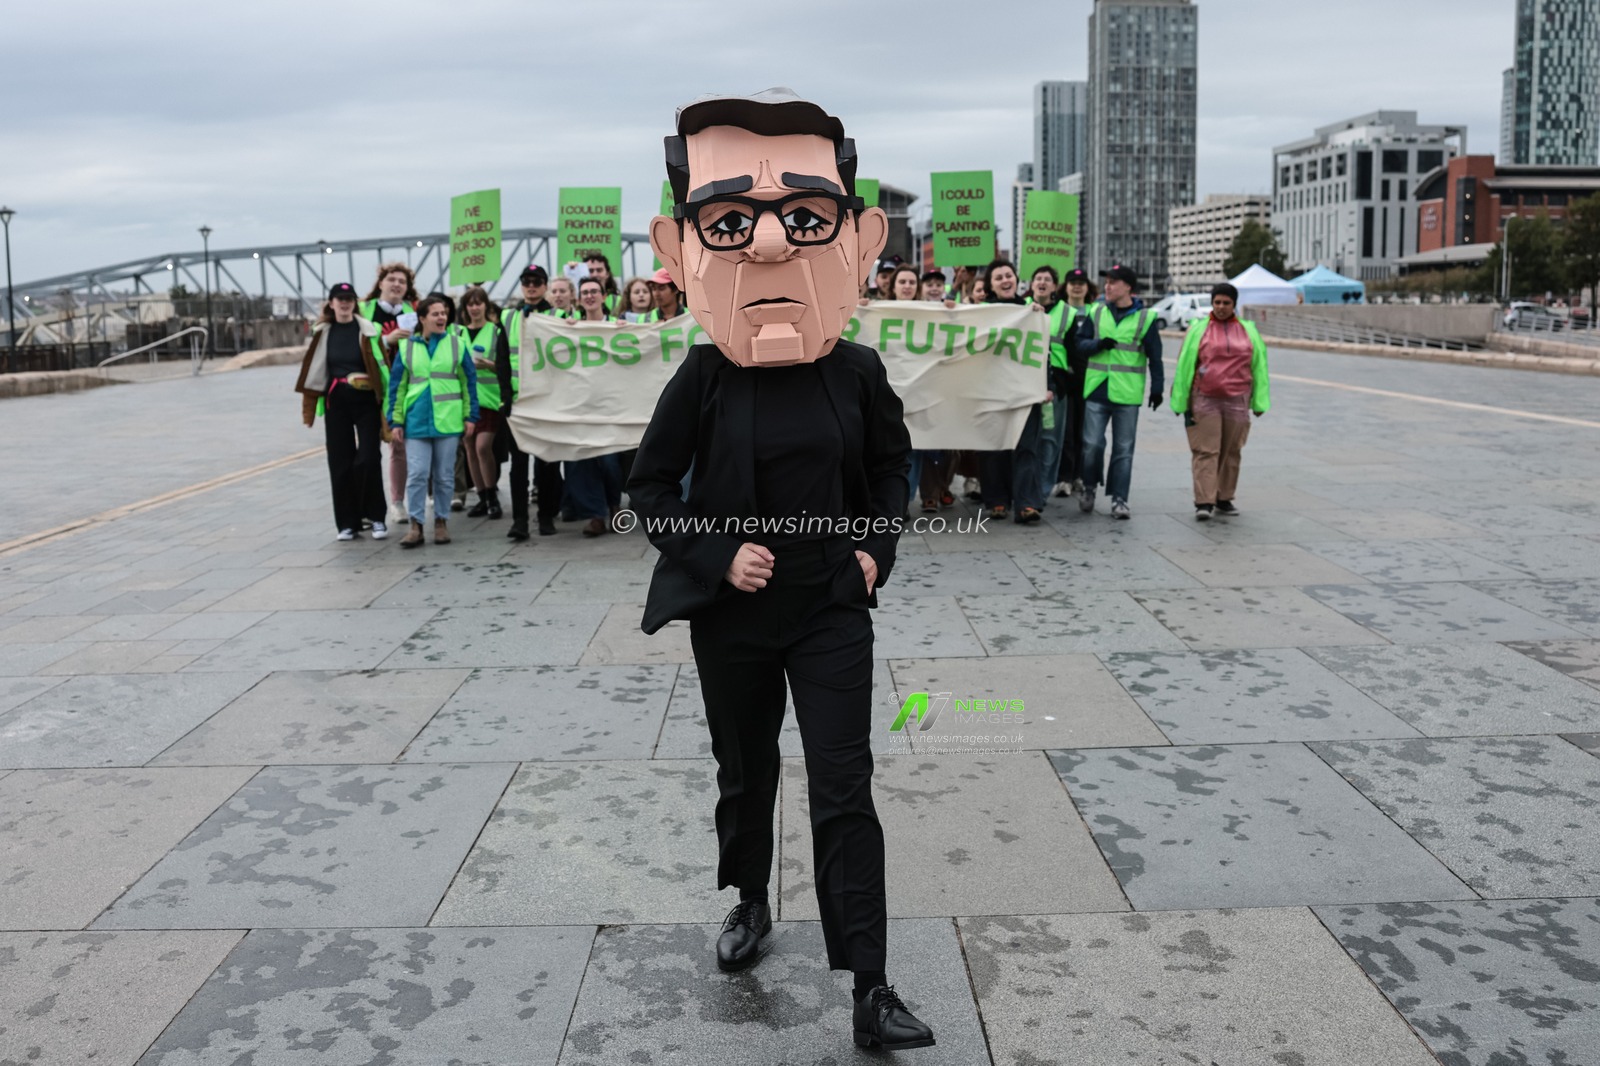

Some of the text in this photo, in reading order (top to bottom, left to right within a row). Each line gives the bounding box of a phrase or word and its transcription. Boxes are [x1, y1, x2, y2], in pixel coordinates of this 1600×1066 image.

[940, 188, 985, 201] I COULD
[560, 205, 618, 215] I COULD BE
[956, 204, 971, 216] BE
[455, 220, 494, 237] APPLIED
[564, 219, 614, 230] FIGHTING
[935, 220, 991, 233] PLANTING
[1031, 220, 1064, 232] COULD
[1064, 223, 1073, 234] BE
[453, 236, 496, 254] FOR 300
[567, 234, 612, 244] CLIMATE
[947, 236, 981, 248] TREES
[1025, 233, 1073, 247] PROTECTING
[1026, 246, 1045, 255] OUR
[462, 254, 485, 268] JOBS
[532, 333, 642, 372] JOBS
[879, 318, 1044, 369] FUTURE
